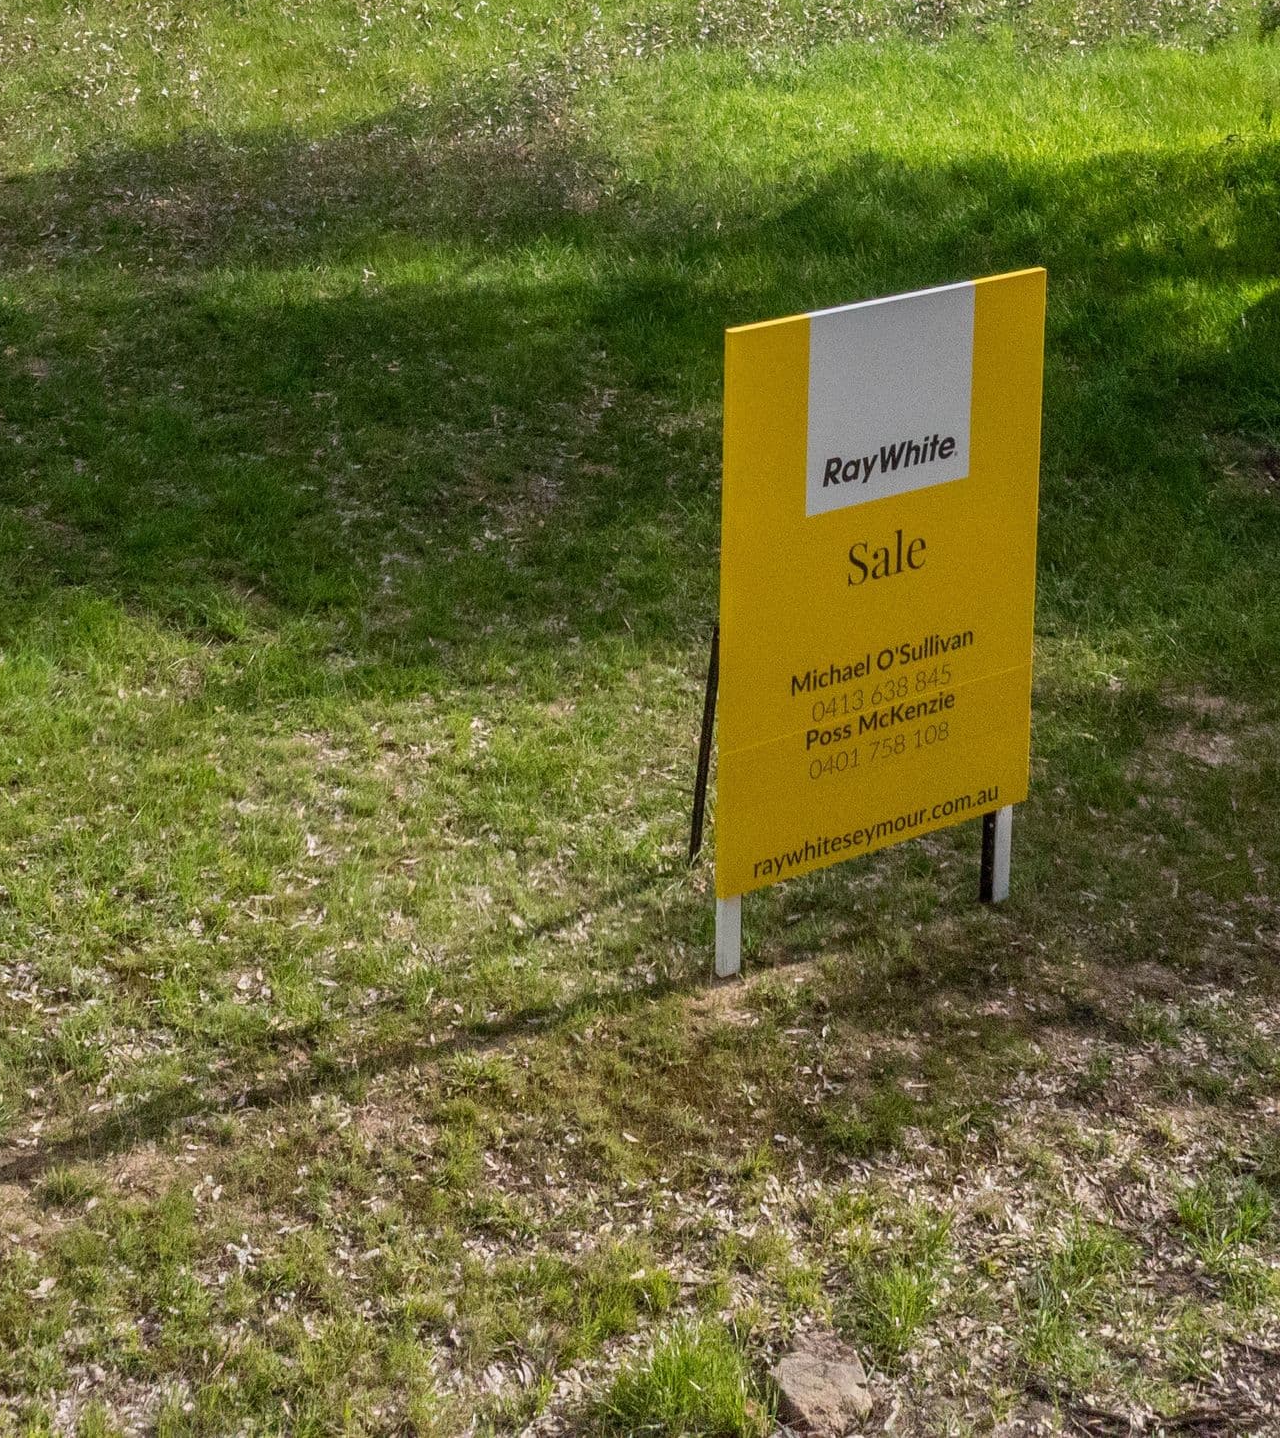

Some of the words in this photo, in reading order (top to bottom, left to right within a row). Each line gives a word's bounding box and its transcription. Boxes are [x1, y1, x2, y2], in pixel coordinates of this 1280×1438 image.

[847, 529, 927, 587] Sale
[791, 653, 871, 696] Michael
[876, 630, 974, 671] O'Sullivan
[806, 724, 852, 750] Poss
[858, 691, 956, 735] McKenzie
[812, 689, 865, 722] 0413
[871, 676, 909, 706] 638
[915, 664, 952, 692] 845
[809, 748, 861, 780] 0401
[869, 734, 906, 761] 758
[914, 722, 950, 750] 108
[753, 786, 999, 879] raywhiteseymour.com.au
